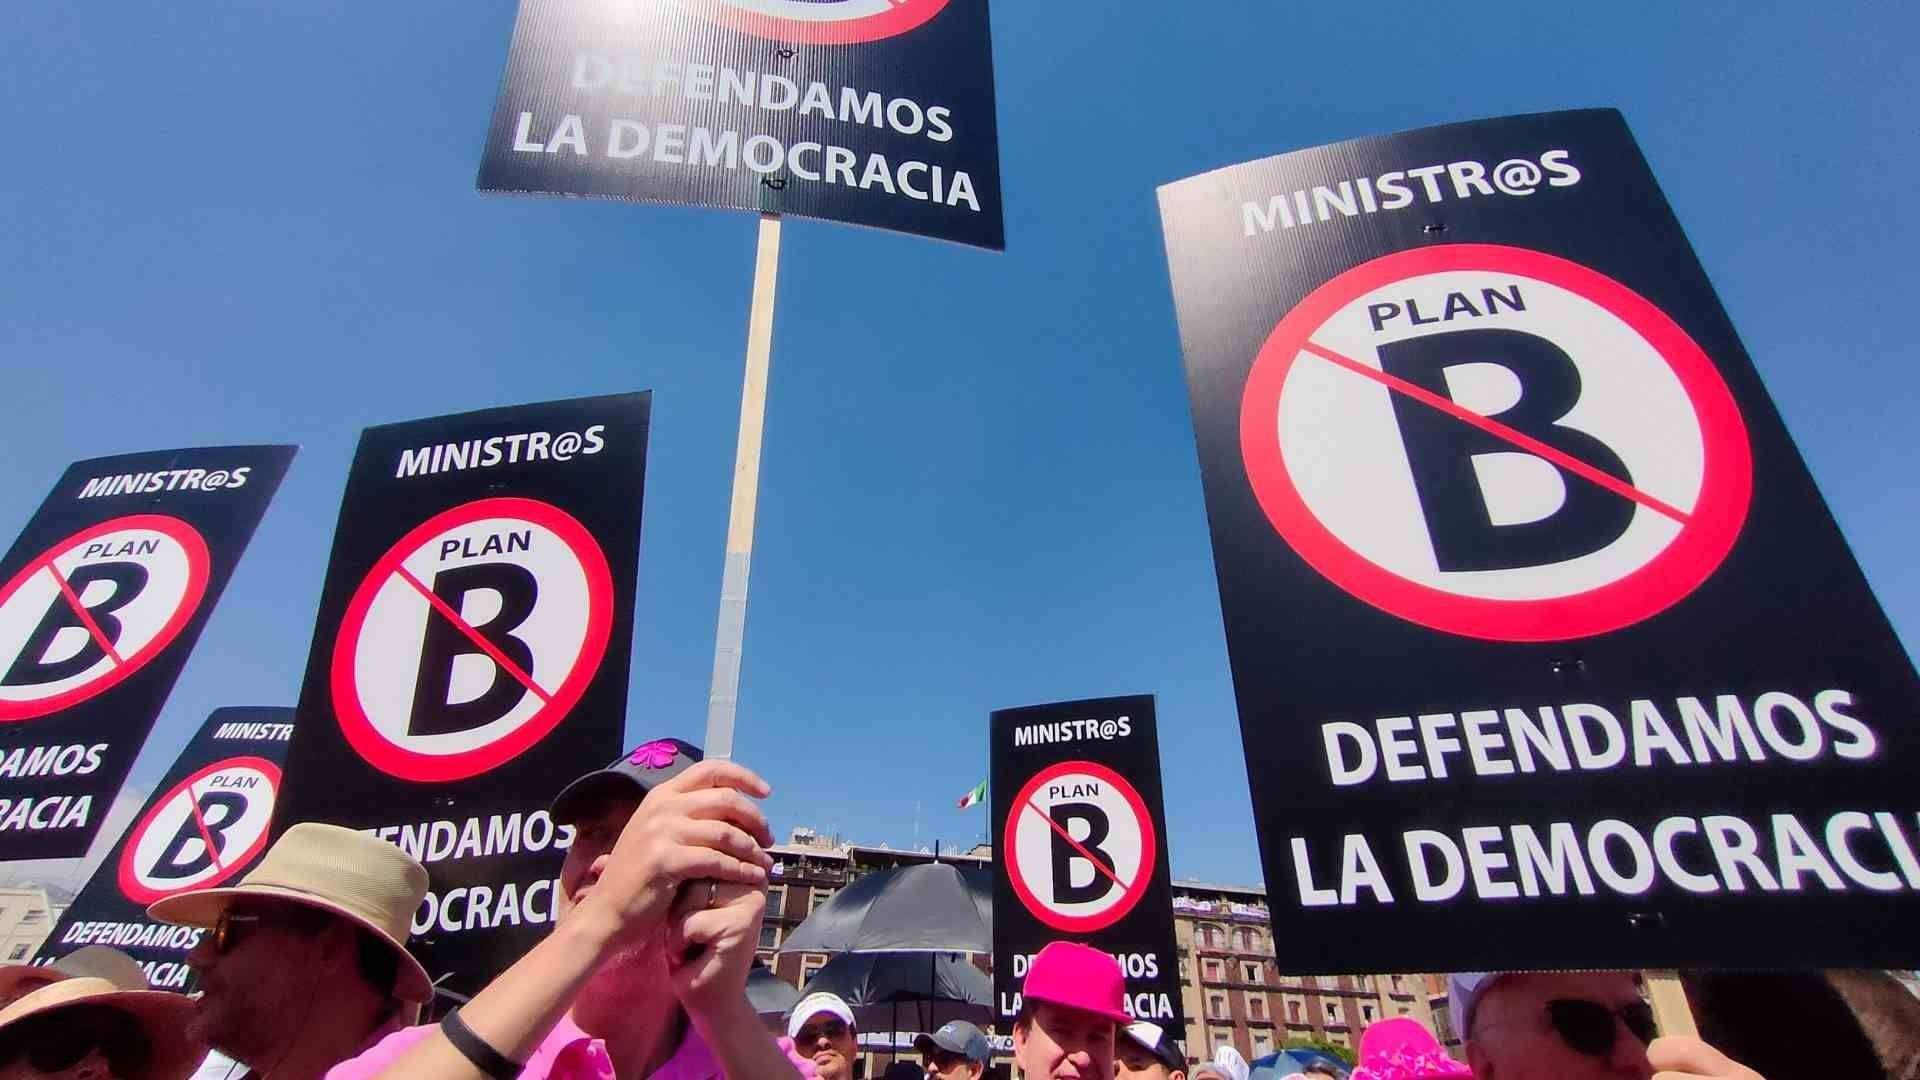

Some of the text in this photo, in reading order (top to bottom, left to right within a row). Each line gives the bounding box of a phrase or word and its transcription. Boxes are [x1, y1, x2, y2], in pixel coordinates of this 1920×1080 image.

[512, 112, 981, 212] LA DEMOCRACIA
[1241, 149, 1582, 236] MINISTR@S
[1367, 285, 1527, 332] PLAN
[395, 425, 605, 478] MINISTR@S
[1376, 328, 1637, 573] B
[78, 466, 251, 500] MINISTR@S
[82, 538, 161, 560] PLAN
[439, 530, 532, 561] PLAN
[1, 562, 149, 687] B
[407, 563, 538, 737] B
[213, 723, 294, 741] MINISTR
[1014, 716, 1131, 746] MINISTR@S
[1322, 689, 1876, 786] DEFENDAMOS
[209, 775, 259, 789] PLAN
[1048, 783, 1099, 799] PLAN
[146, 791, 248, 880] B
[1049, 803, 1115, 905] B
[1291, 810, 1920, 906] LA DEMOCRACI
[62, 921, 205, 949] DEFENDAMOS
